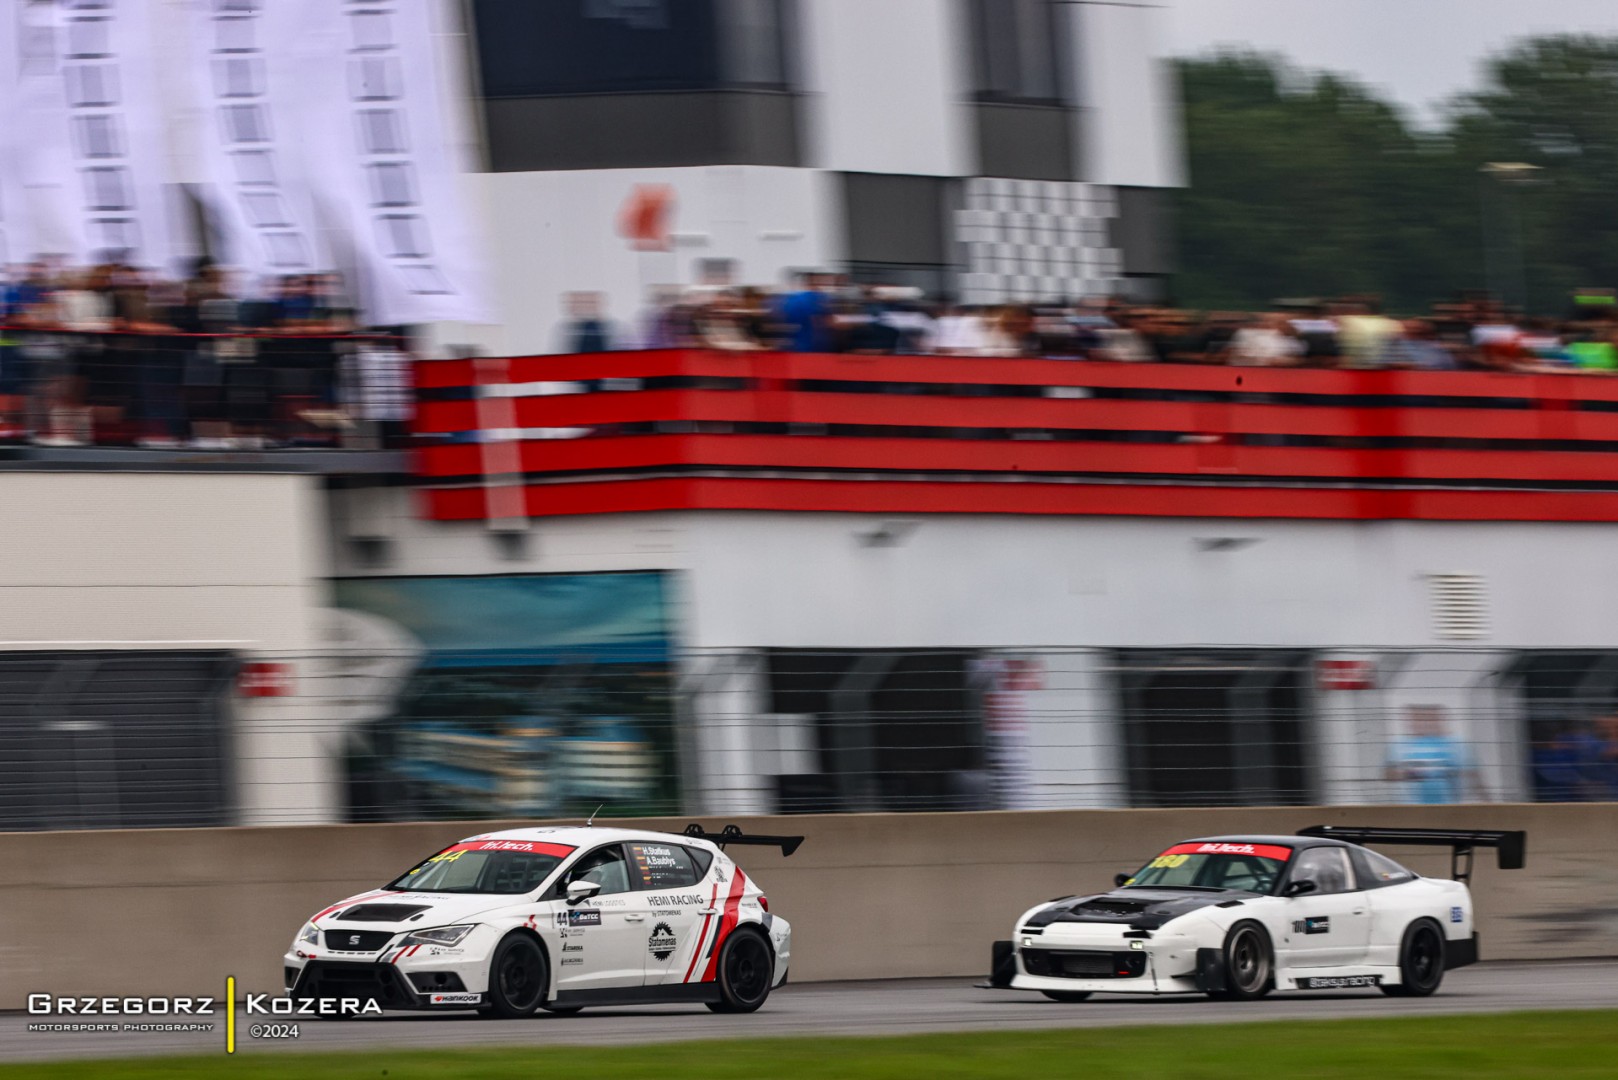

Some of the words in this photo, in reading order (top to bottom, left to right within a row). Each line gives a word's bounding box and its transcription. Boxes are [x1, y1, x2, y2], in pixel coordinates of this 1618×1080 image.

[428, 849, 468, 863] 44
[648, 897, 671, 907] HEMI
[671, 894, 704, 905] RACING
[557, 912, 567, 925] 44
